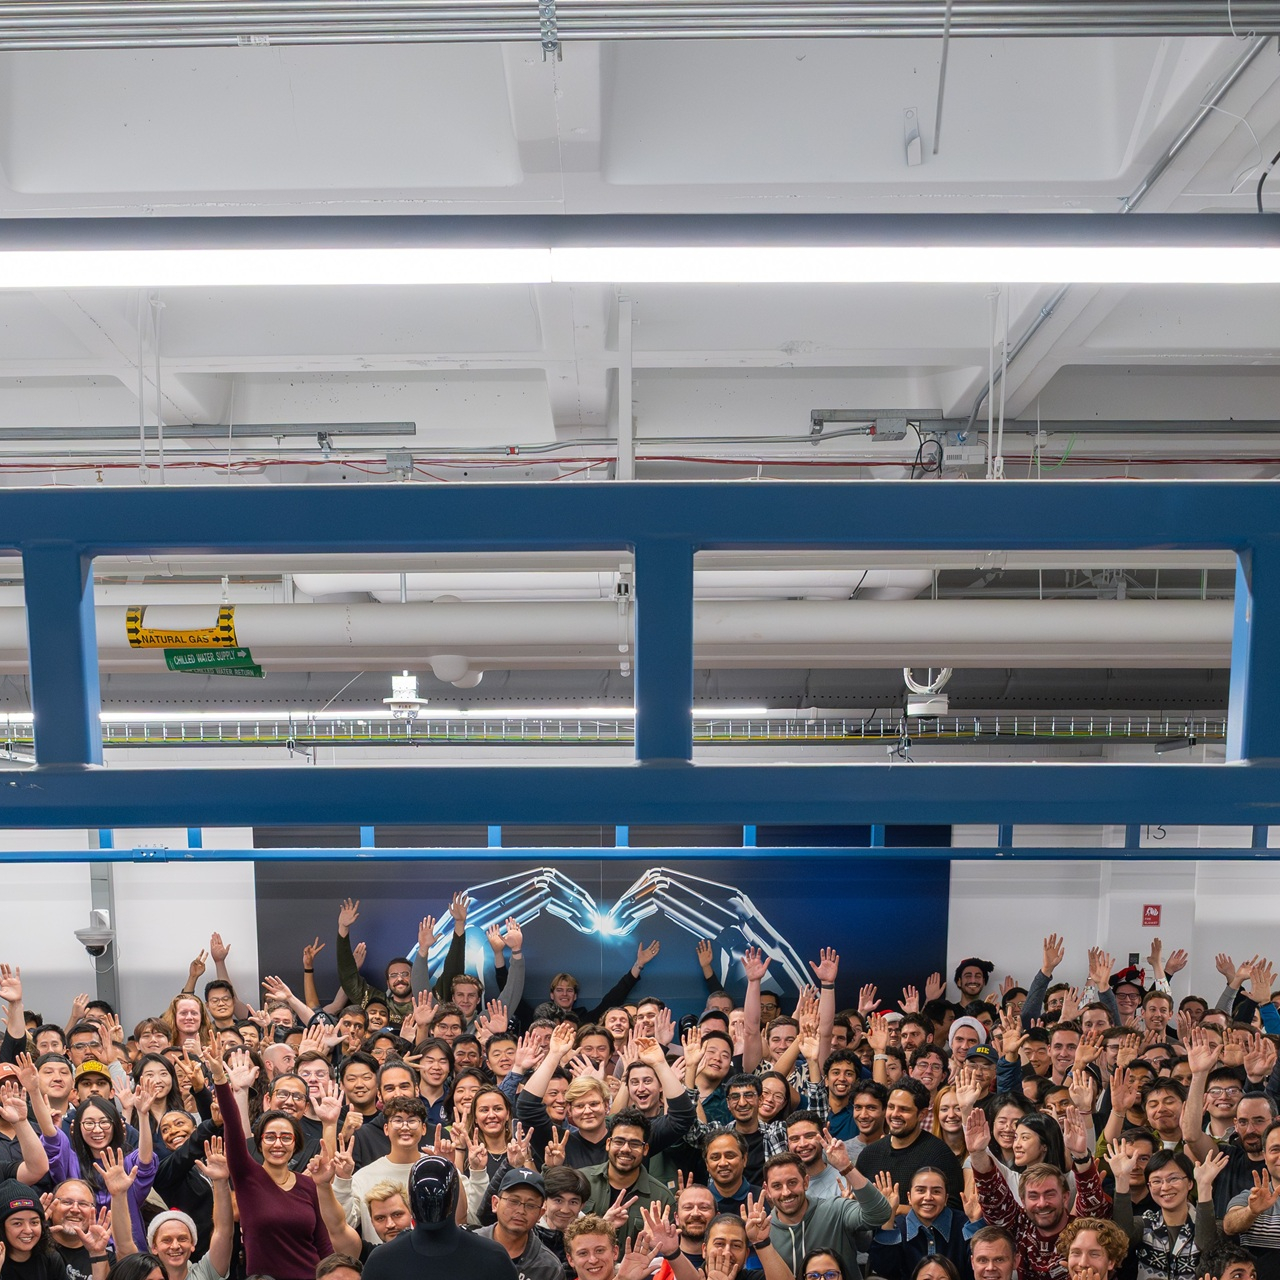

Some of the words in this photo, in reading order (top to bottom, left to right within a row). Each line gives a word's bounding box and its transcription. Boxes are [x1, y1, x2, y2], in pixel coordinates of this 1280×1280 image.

[141, 635, 187, 644] NATURAL
[188, 635, 210, 644] GAS
[173, 653, 196, 666] CHILLED
[197, 652, 215, 663] WATER
[216, 650, 236, 661] SUPPLY
[234, 669, 255, 677] RETURN
